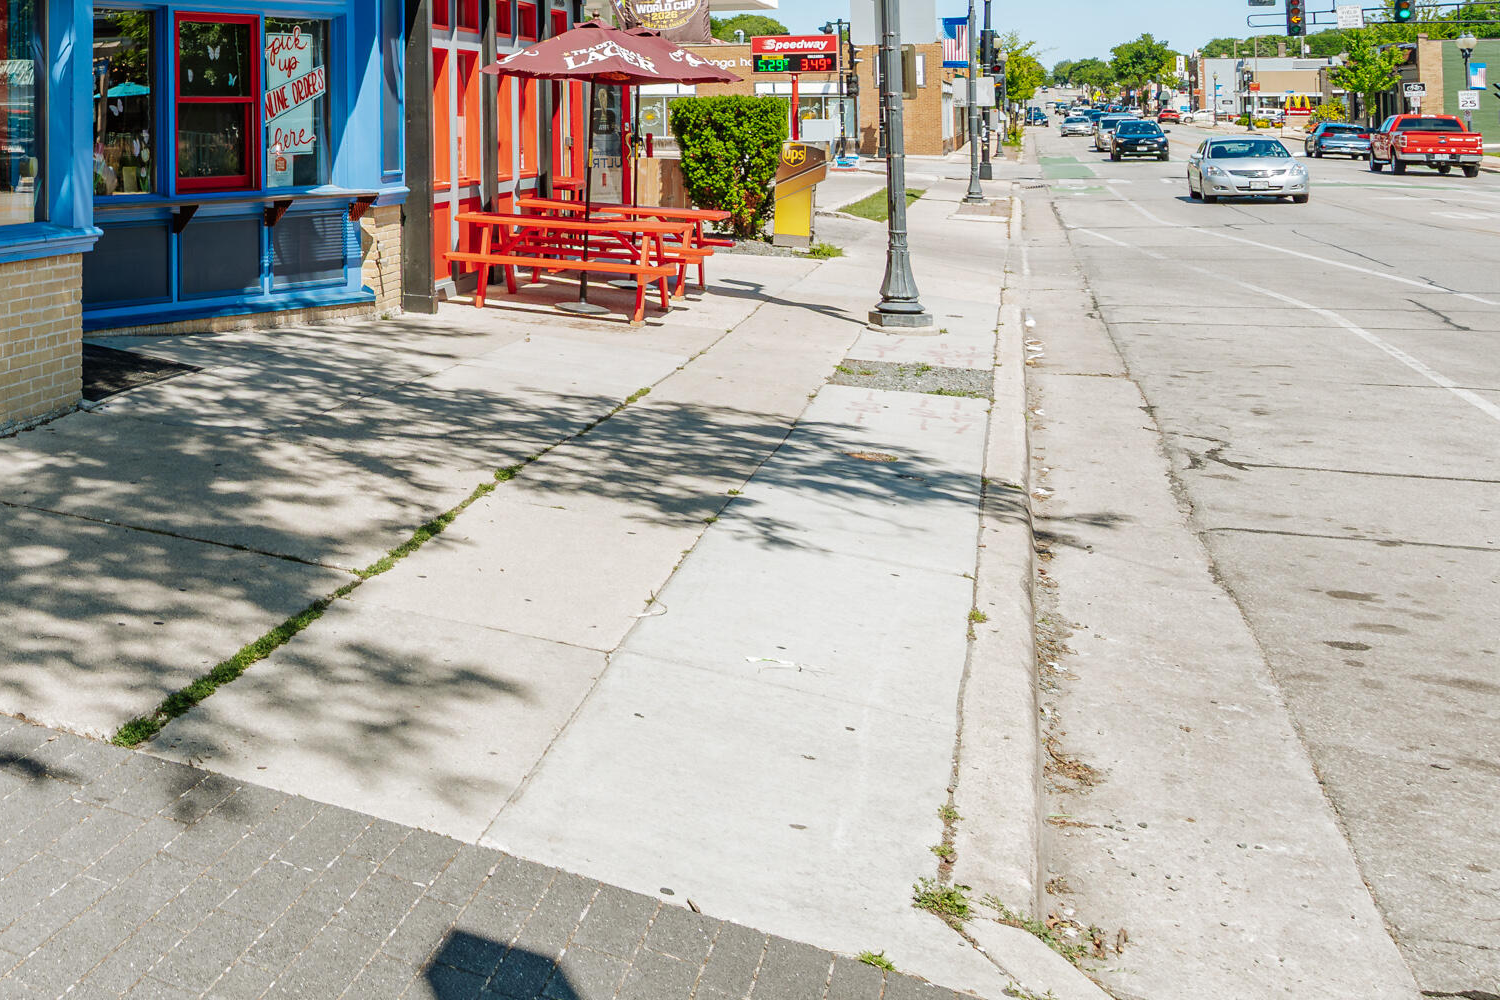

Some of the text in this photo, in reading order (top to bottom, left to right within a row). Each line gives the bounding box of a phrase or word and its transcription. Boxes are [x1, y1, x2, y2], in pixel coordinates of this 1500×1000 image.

[635, 0, 696, 14] WORLD CUP
[651, 10, 678, 21] 2026
[266, 27, 308, 67] pick
[764, 39, 828, 51] Speedway
[278, 56, 300, 78] up
[563, 45, 660, 75] LAGER
[265, 68, 324, 119] NLINE ORDERS
[1461, 100, 1477, 108] 25
[269, 127, 315, 152] here
[784, 149, 805, 164] ups
